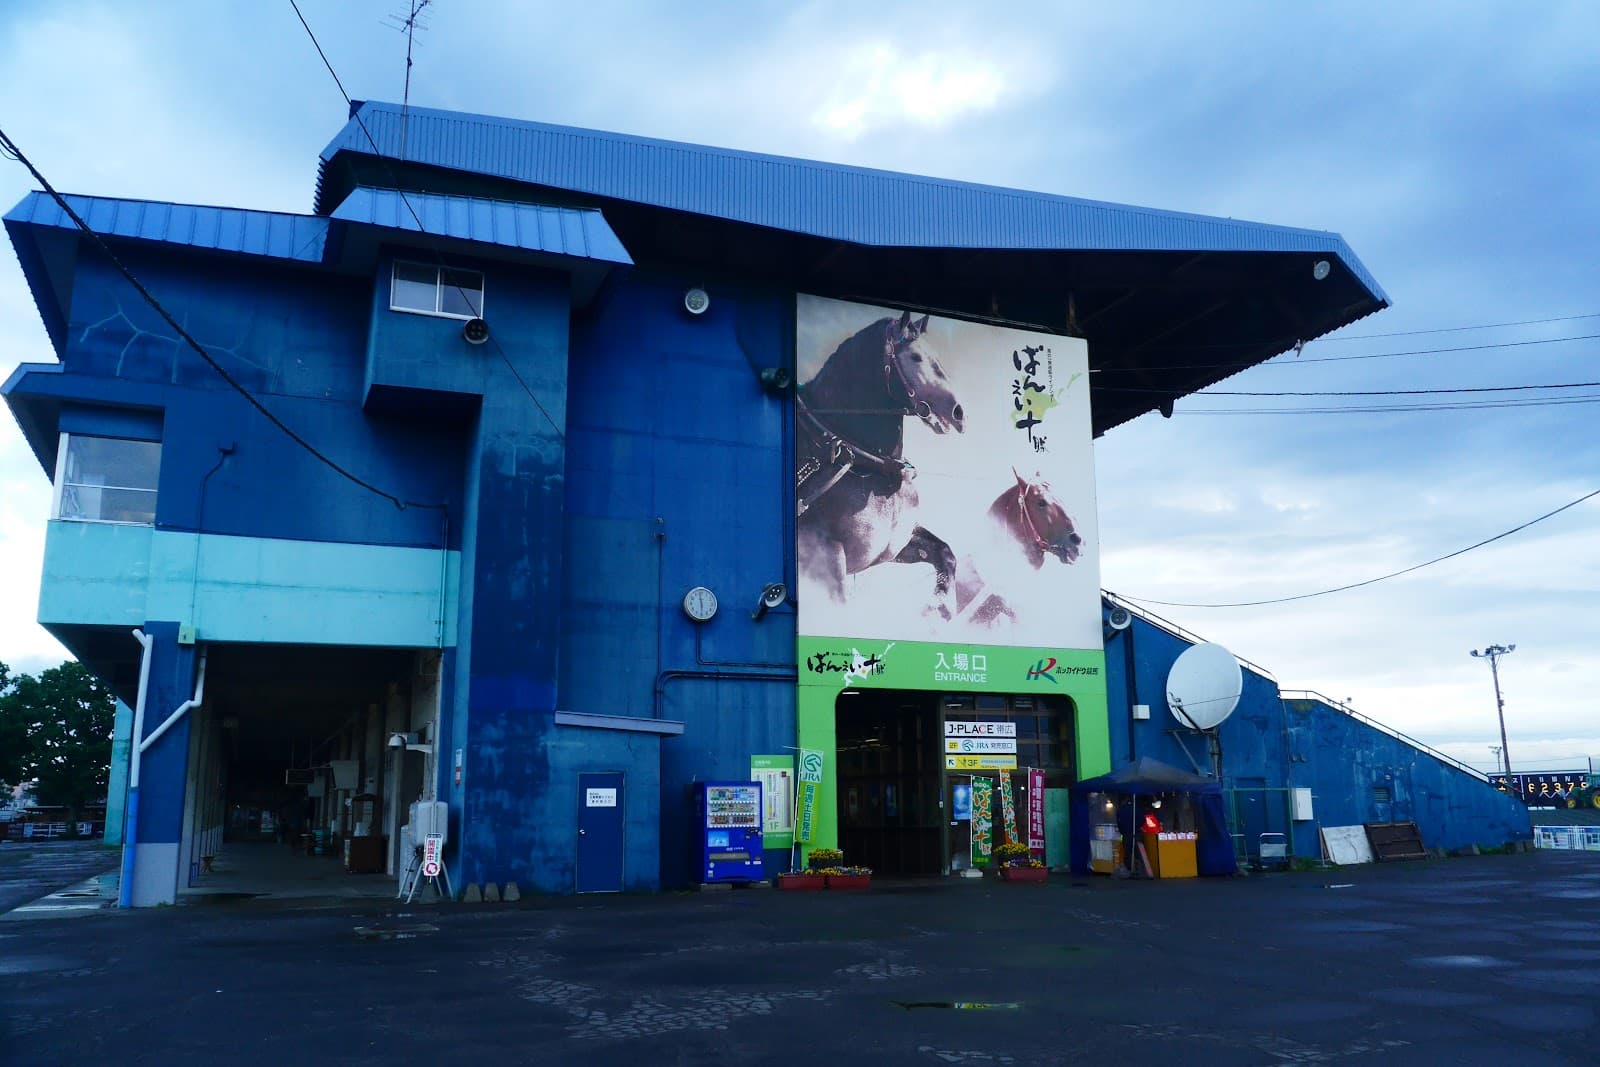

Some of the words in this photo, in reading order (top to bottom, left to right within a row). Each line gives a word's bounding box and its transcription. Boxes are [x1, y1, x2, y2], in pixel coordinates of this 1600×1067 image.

[934, 652, 987, 671] 入場口
[934, 671, 987, 683] ENTRANCE
[804, 773, 820, 782] JRA
